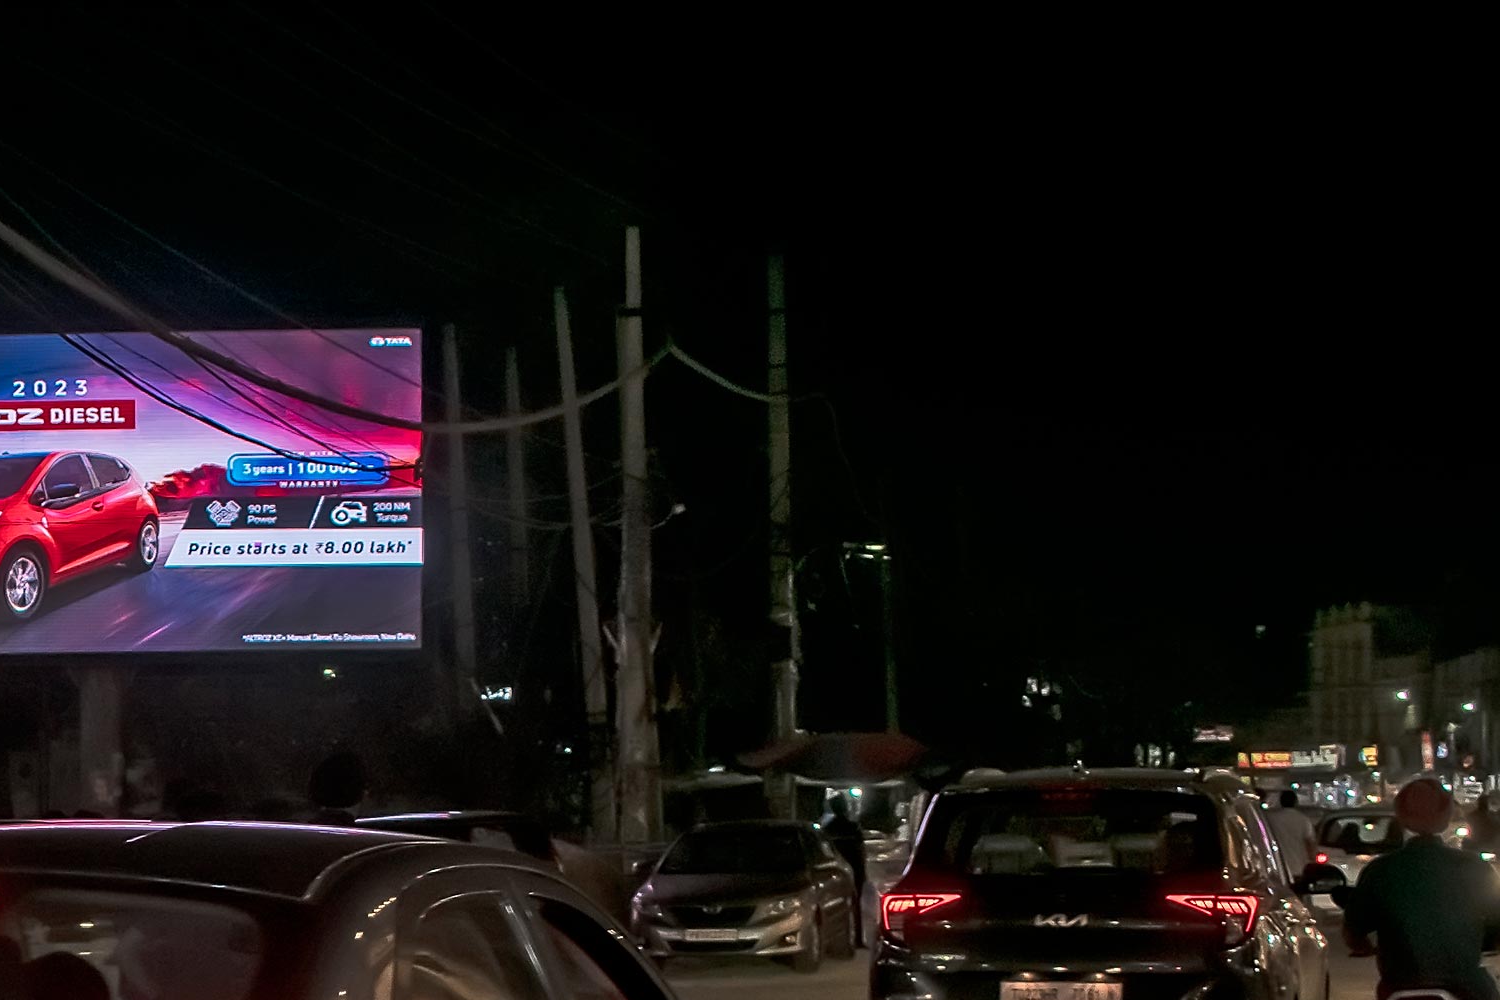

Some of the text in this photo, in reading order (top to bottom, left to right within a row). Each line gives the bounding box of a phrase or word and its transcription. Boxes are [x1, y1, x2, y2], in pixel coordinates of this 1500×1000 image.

[12, 379, 88, 398] 2023
[50, 406, 126, 425] DIESEL
[242, 463, 252, 475] 3
[253, 464, 285, 476] years
[247, 503, 278, 515] 90 PS
[372, 501, 392, 512] 200
[247, 514, 278, 525] Power
[375, 513, 409, 524] Torque
[187, 541, 231, 555] Price
[237, 541, 286, 555] starts
[292, 542, 309, 554] at
